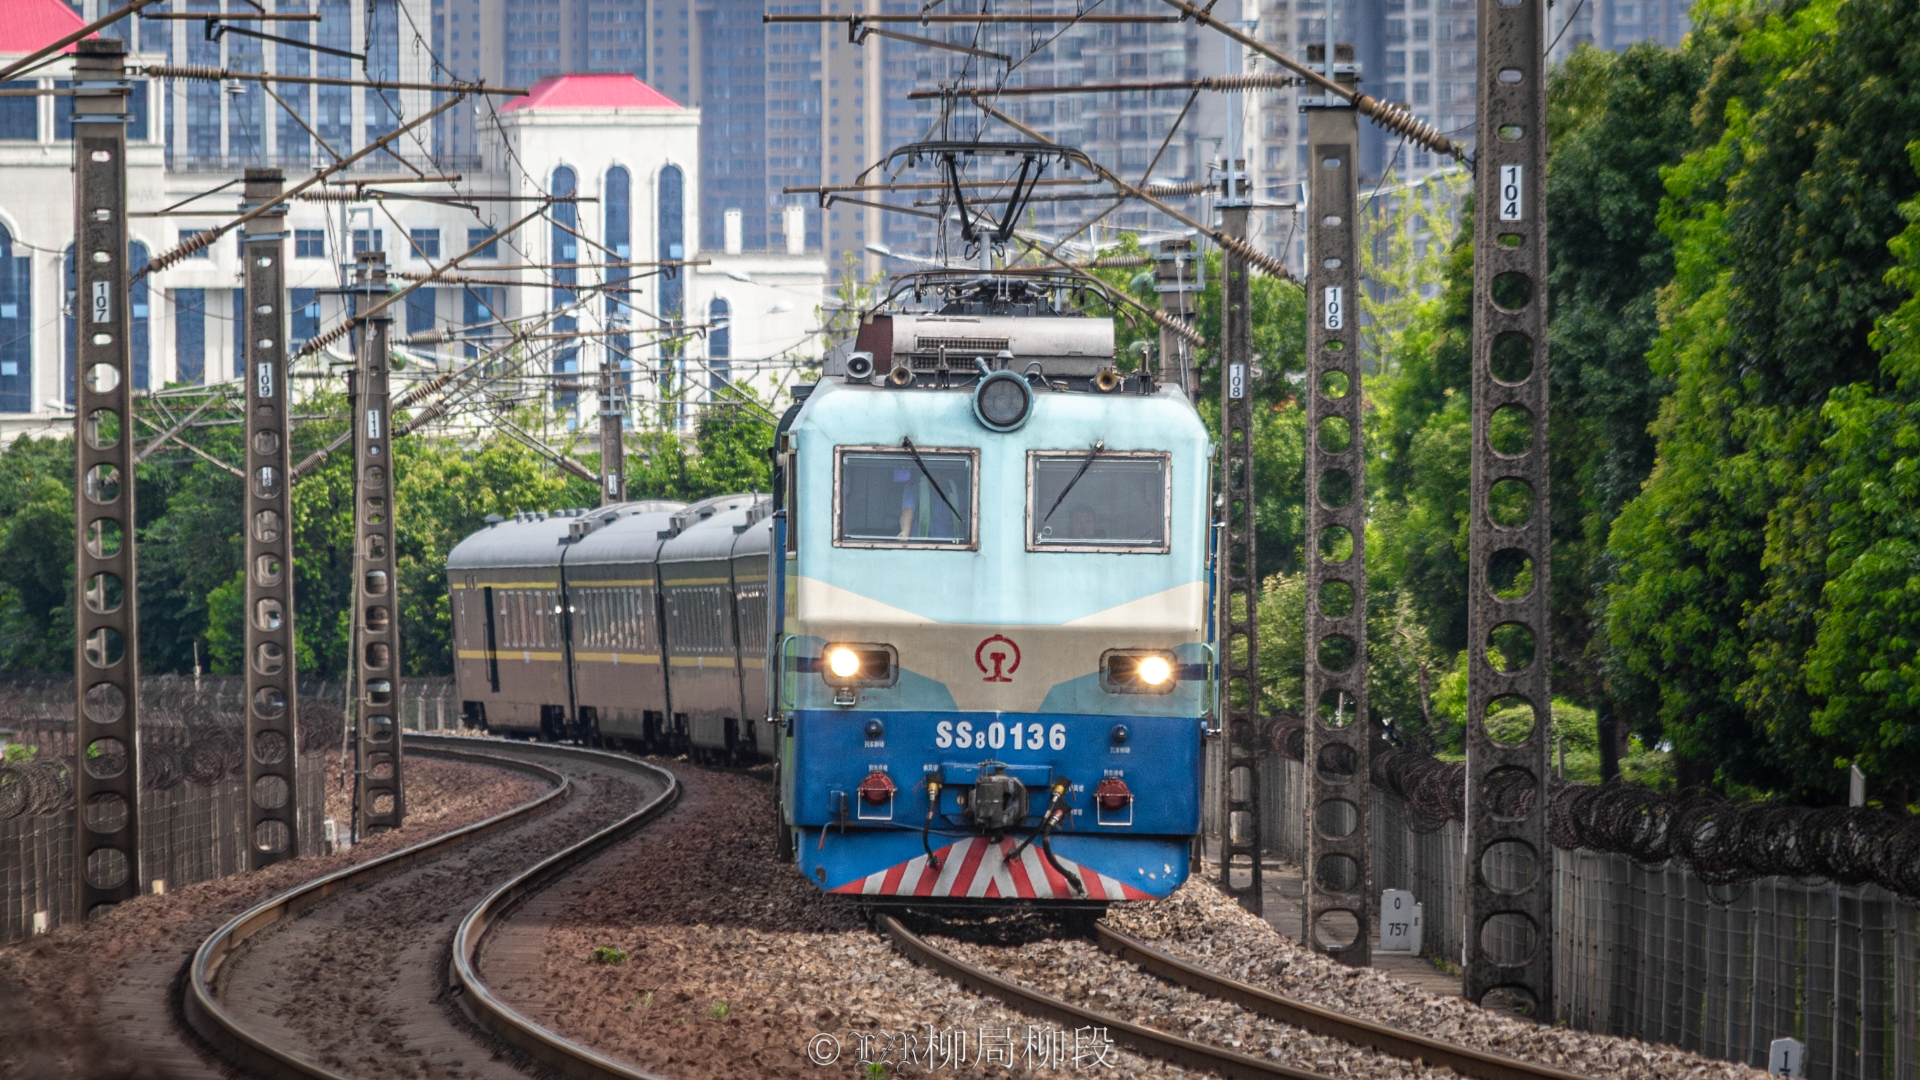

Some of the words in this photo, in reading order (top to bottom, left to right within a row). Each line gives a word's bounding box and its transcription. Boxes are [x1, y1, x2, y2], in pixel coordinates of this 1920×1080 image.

[1503, 167, 1518, 219] 104
[96, 282, 107, 321] 107
[1328, 288, 1339, 328] 106
[261, 364, 270, 396] 109
[1232, 365, 1241, 397] 108
[1394, 897, 1401, 910] 0
[1388, 923, 1409, 936] 757
